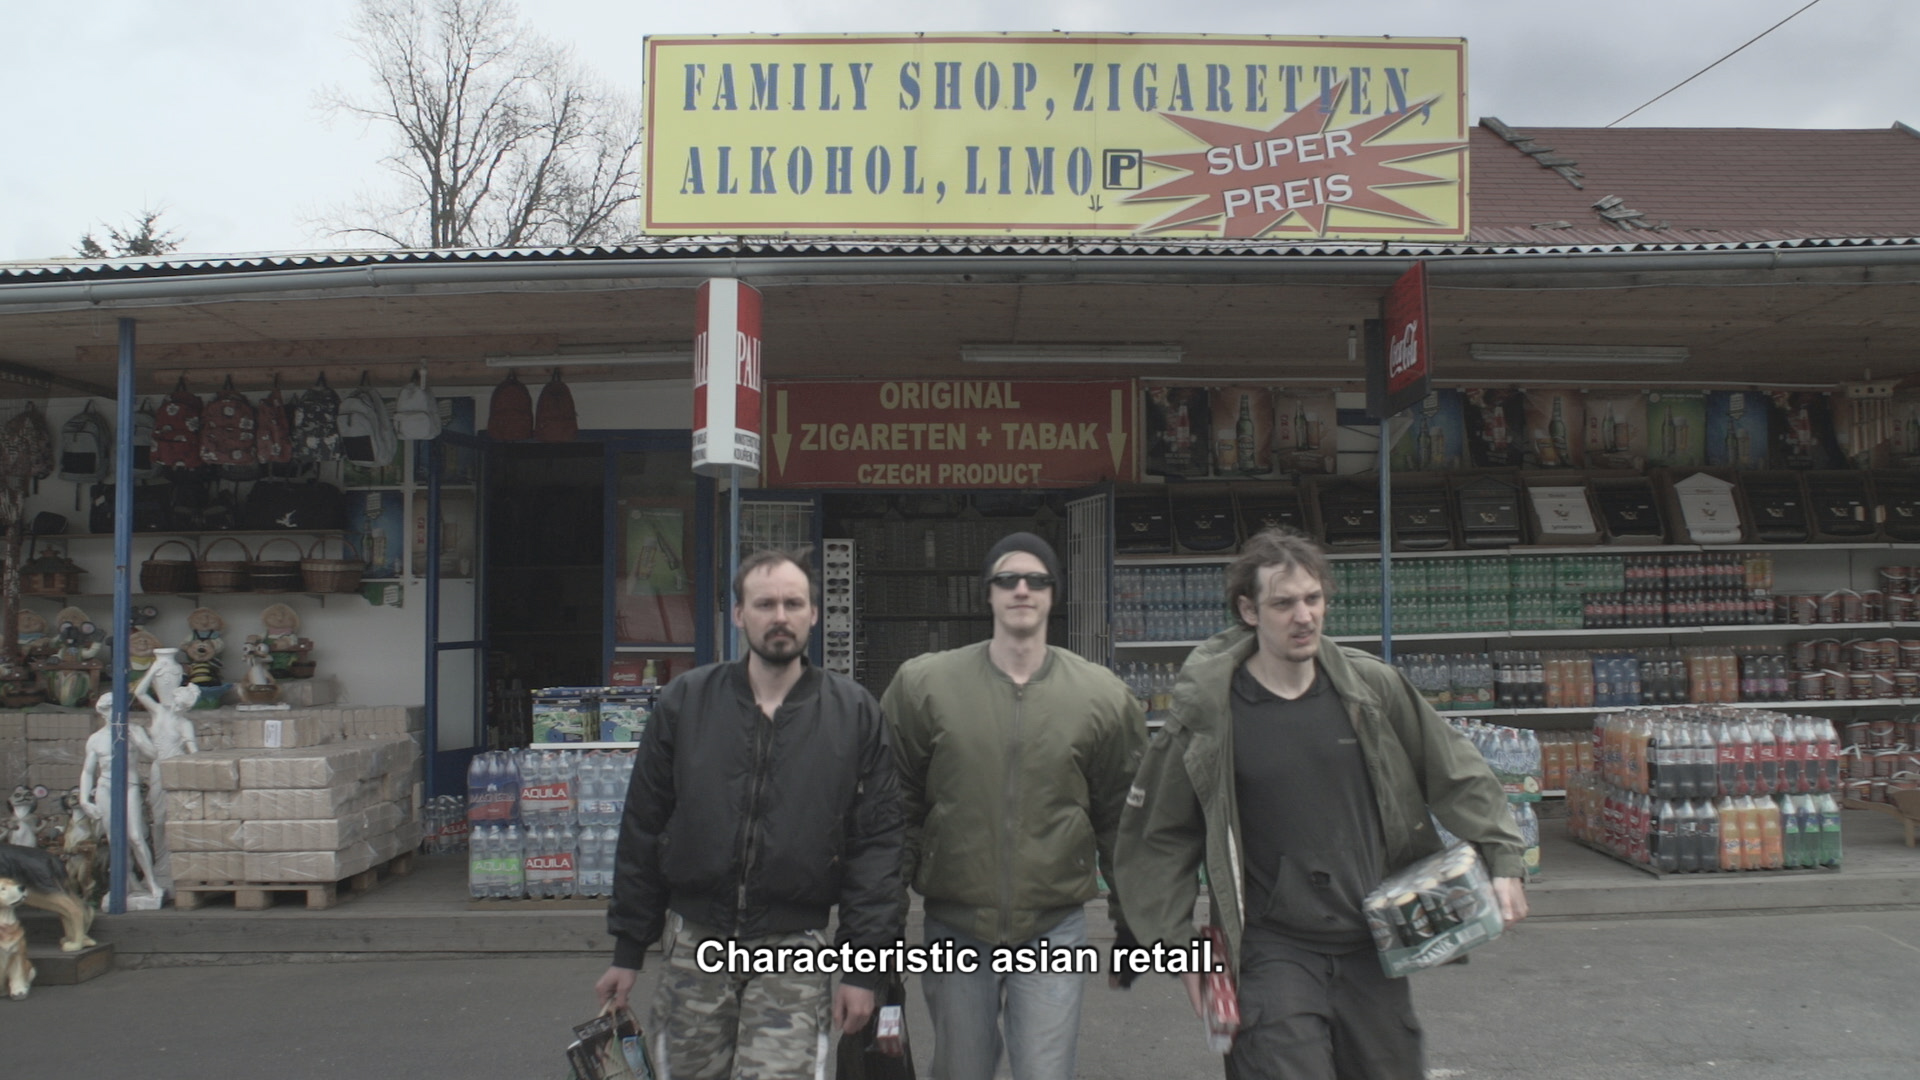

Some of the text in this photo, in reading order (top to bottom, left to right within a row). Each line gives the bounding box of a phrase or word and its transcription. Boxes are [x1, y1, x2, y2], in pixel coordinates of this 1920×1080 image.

[683, 61, 1432, 126] FAMILY SHOP, ZIGARETTEN,
[1206, 129, 1356, 175] SUPER
[680, 145, 1093, 204] ALKOHOL, LIMO
[1107, 154, 1137, 187] P
[1223, 173, 1353, 219] PREIS
[879, 382, 1020, 410] ORIGINAL
[799, 422, 1099, 451] ZIGARETEN + TABAK
[857, 463, 1042, 485] CZECH PRODUCT
[522, 787, 567, 800] AQUILA
[474, 862, 518, 873] AQUILA
[526, 857, 571, 870] AQUILA
